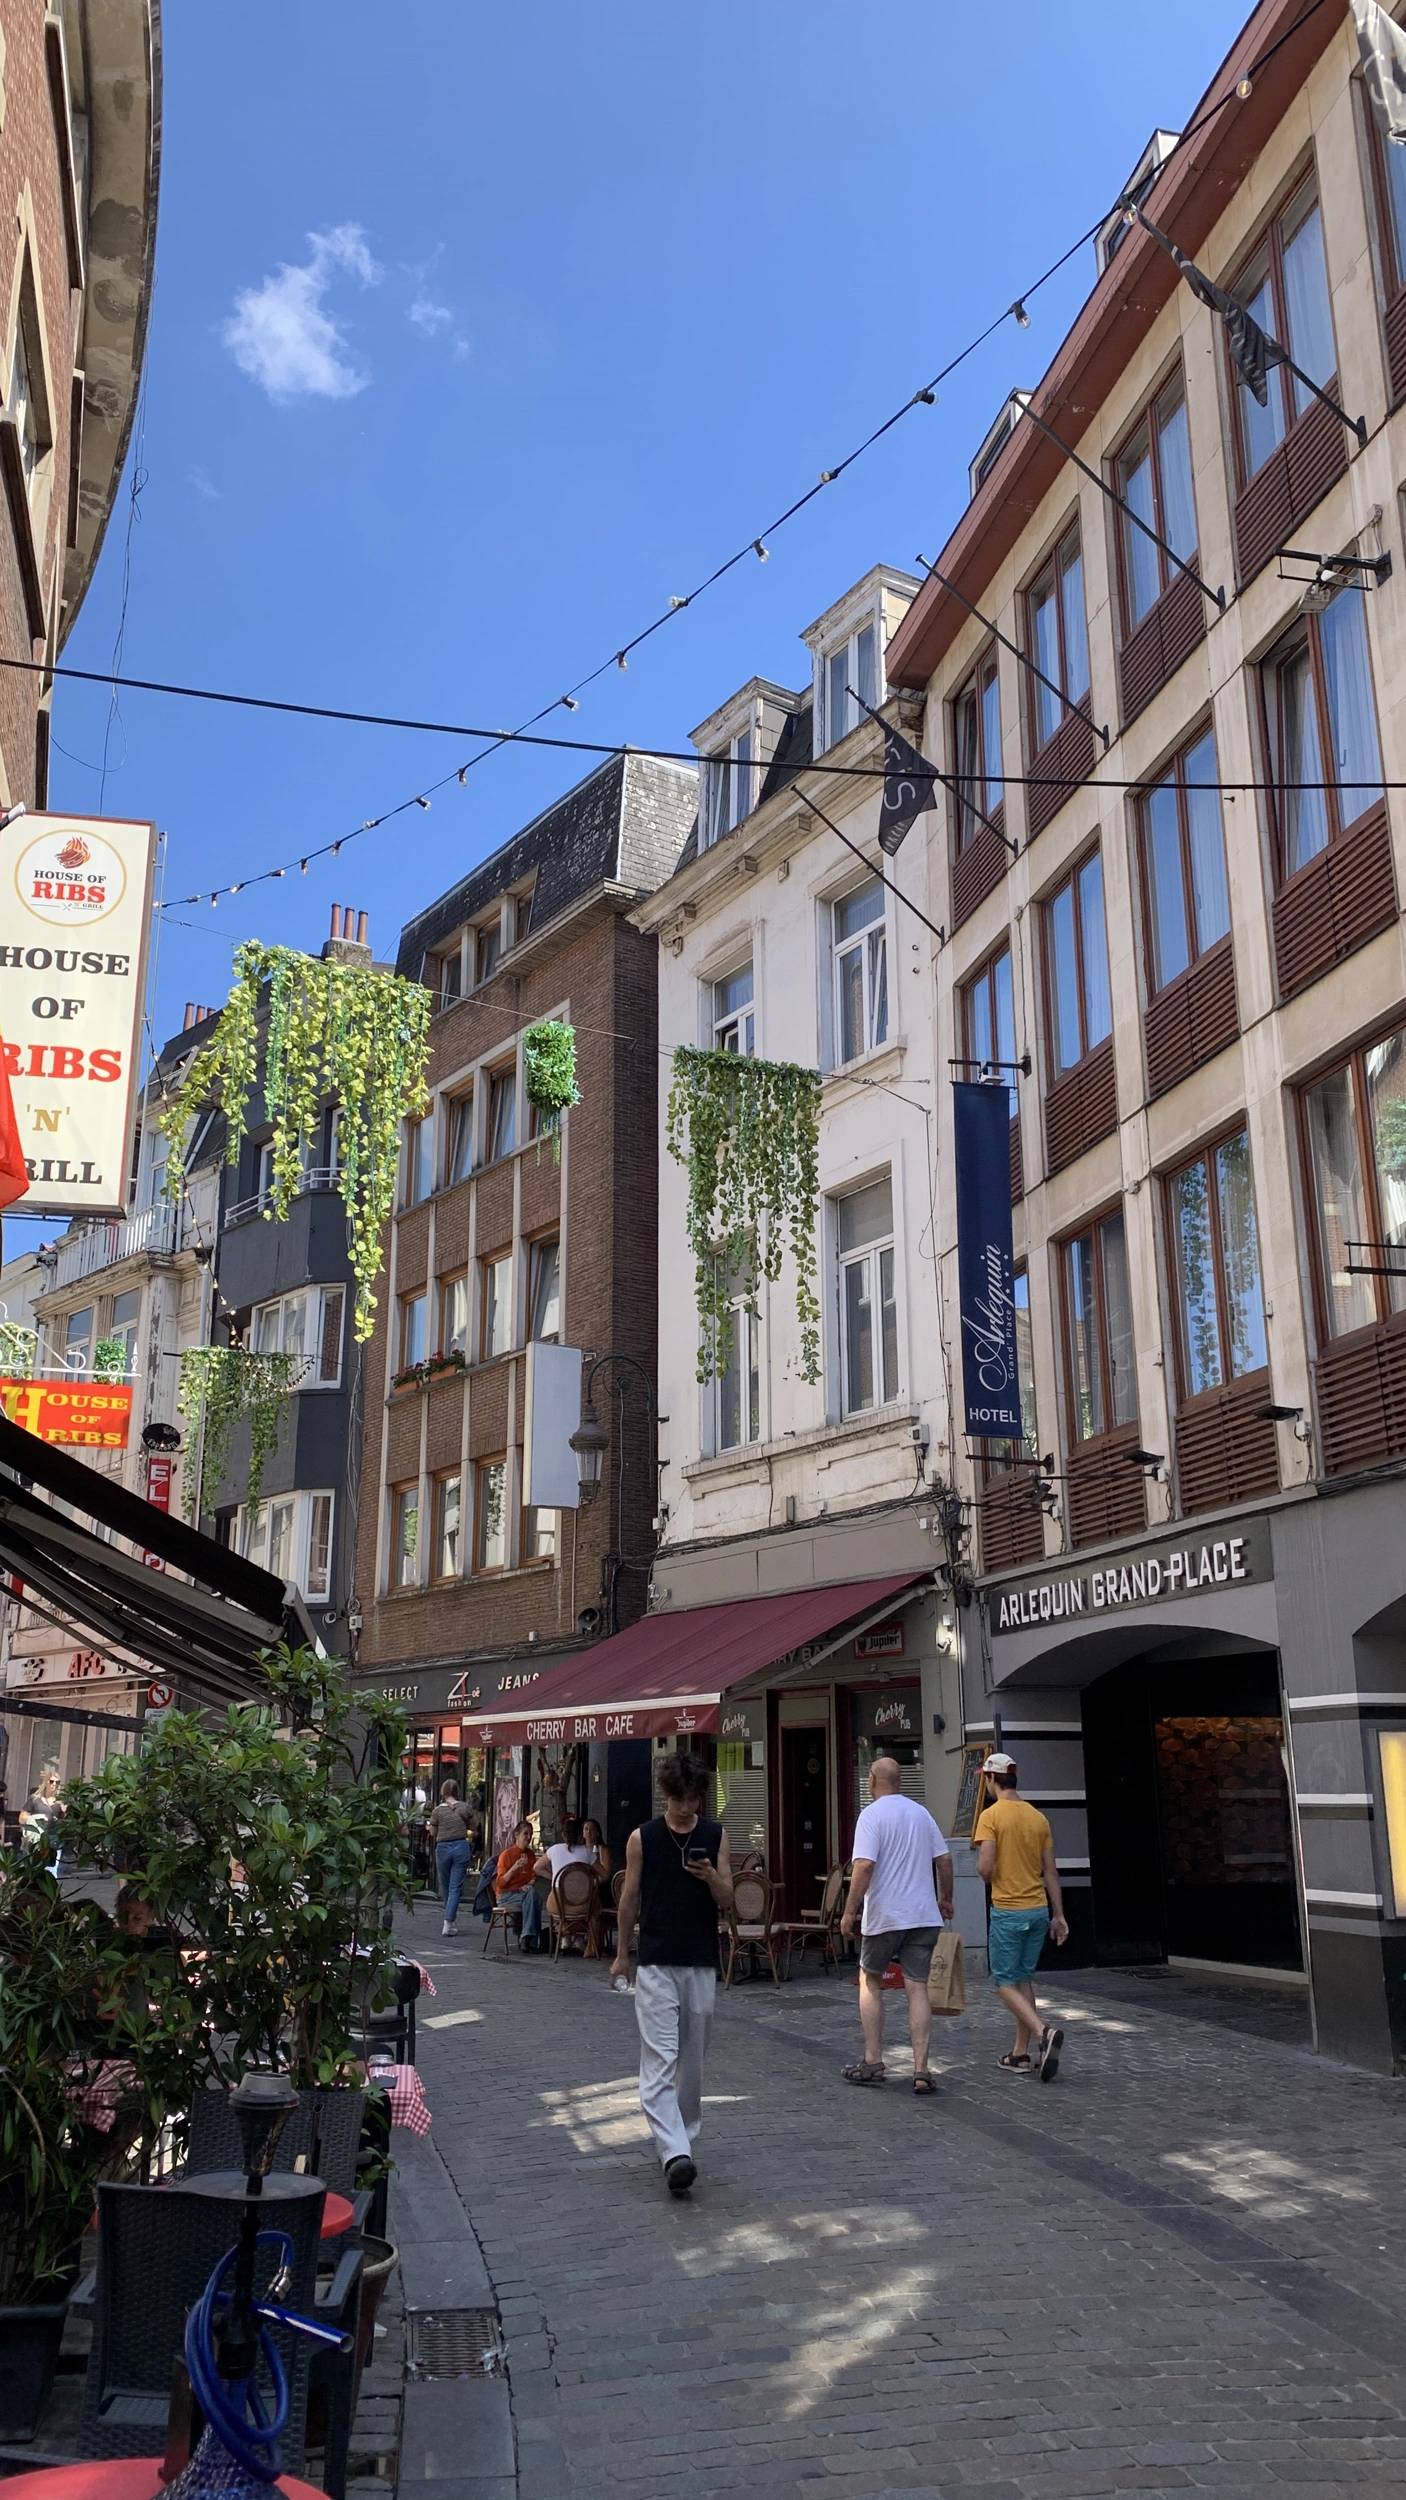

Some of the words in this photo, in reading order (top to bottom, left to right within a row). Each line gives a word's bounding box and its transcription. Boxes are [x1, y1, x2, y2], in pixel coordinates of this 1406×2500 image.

[34, 870, 83, 882] HOUSE
[87, 875, 107, 883] OF
[32, 881, 105, 903] RIBS
[0, 945, 130, 976] HOUSE
[31, 996, 85, 1020] OF
[2, 1042, 122, 1083] RIBS
[27, 1104, 70, 1132] 'N'
[23, 1158, 102, 1184] RILL
[962, 1244, 1015, 1391] Arlequin
[1, 1386, 129, 1438] HOUSE
[70, 1414, 101, 1424] OF
[969, 1407, 1018, 1423] HOTEL
[46, 1428, 122, 1445] RIBS
[1000, 1577, 1083, 1628] ARLEQUIN
[1092, 1538, 1246, 1608] GRAND-PLACE
[67, 1649, 105, 1678] AFC
[382, 1685, 419, 1701] SELECT
[875, 1701, 906, 1727] Cherry
[900, 1719, 912, 1730] PUB
[526, 1719, 566, 1741] CHERRY
[575, 1717, 597, 1738] BAR
[605, 1714, 634, 1736] CAFE
